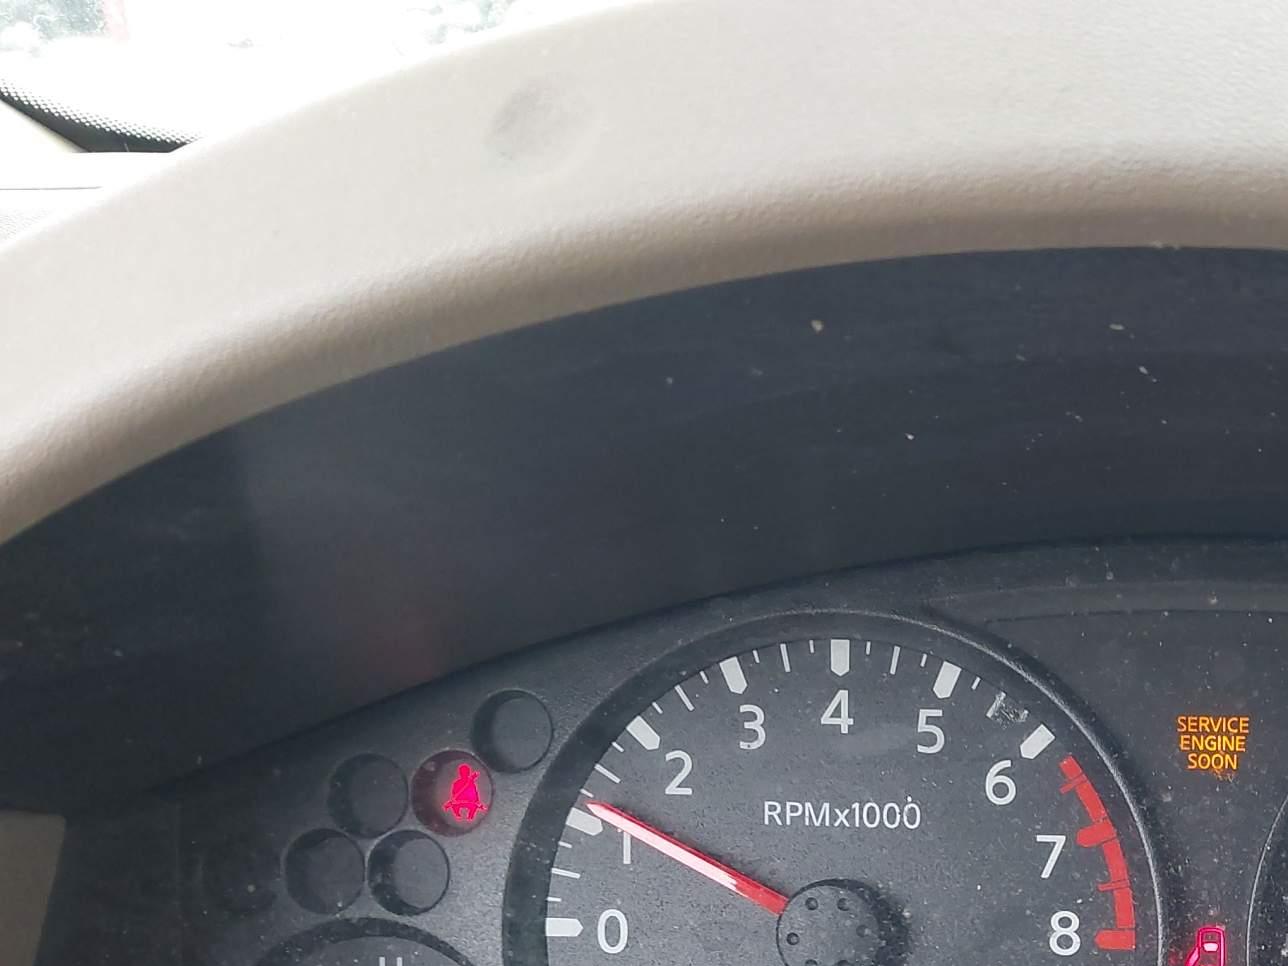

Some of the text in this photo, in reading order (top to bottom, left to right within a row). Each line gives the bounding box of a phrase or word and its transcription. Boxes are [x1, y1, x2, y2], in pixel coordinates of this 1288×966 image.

[739, 704, 766, 750] 3
[821, 690, 853, 733] 4
[916, 709, 945, 754] 5
[1177, 715, 1250, 734] SERVICE
[1180, 734, 1246, 752] ENGINE
[1187, 752, 1238, 770] SOON
[664, 751, 693, 795] 2
[985, 759, 1017, 805] 6
[763, 800, 922, 830] RPMx1000
[617, 826, 632, 865] 1
[1036, 834, 1066, 879] 7
[597, 909, 629, 955] 0
[1048, 910, 1081, 956] 8
